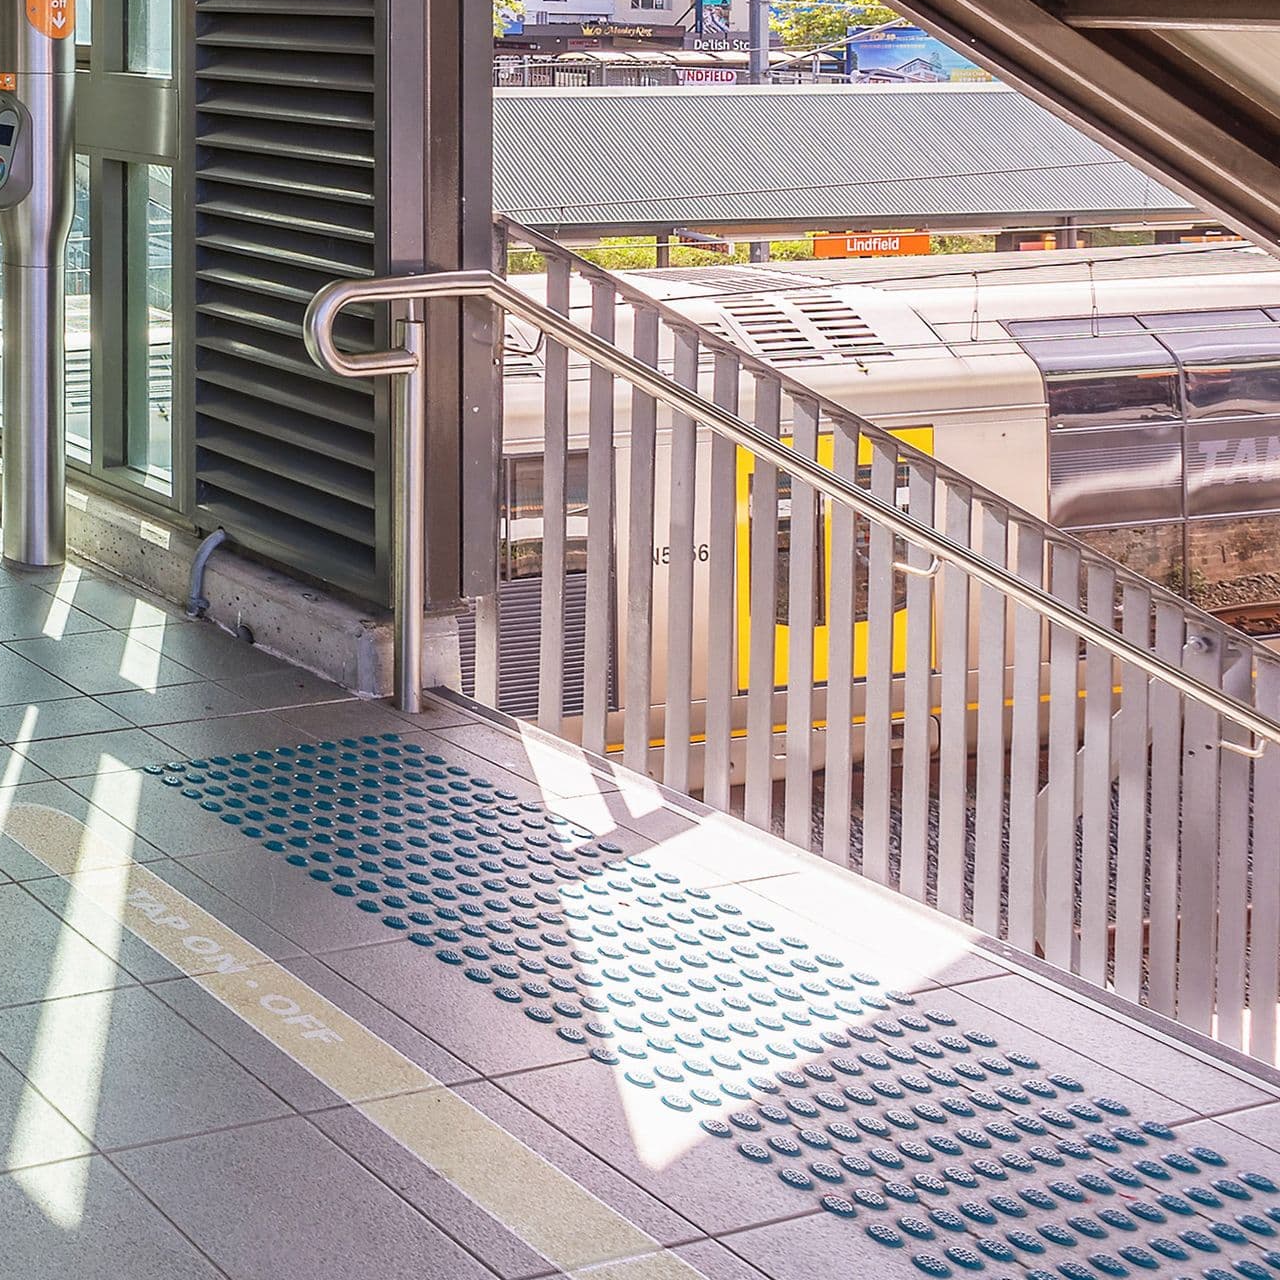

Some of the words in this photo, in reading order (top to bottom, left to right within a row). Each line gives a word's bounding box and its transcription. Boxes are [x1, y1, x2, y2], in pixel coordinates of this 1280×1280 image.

[846, 237, 900, 252] Lindfield
[1197, 435, 1280, 486] TA
[127, 888, 191, 931] TAP
[182, 935, 249, 974] ON
[259, 993, 344, 1044] OFF
